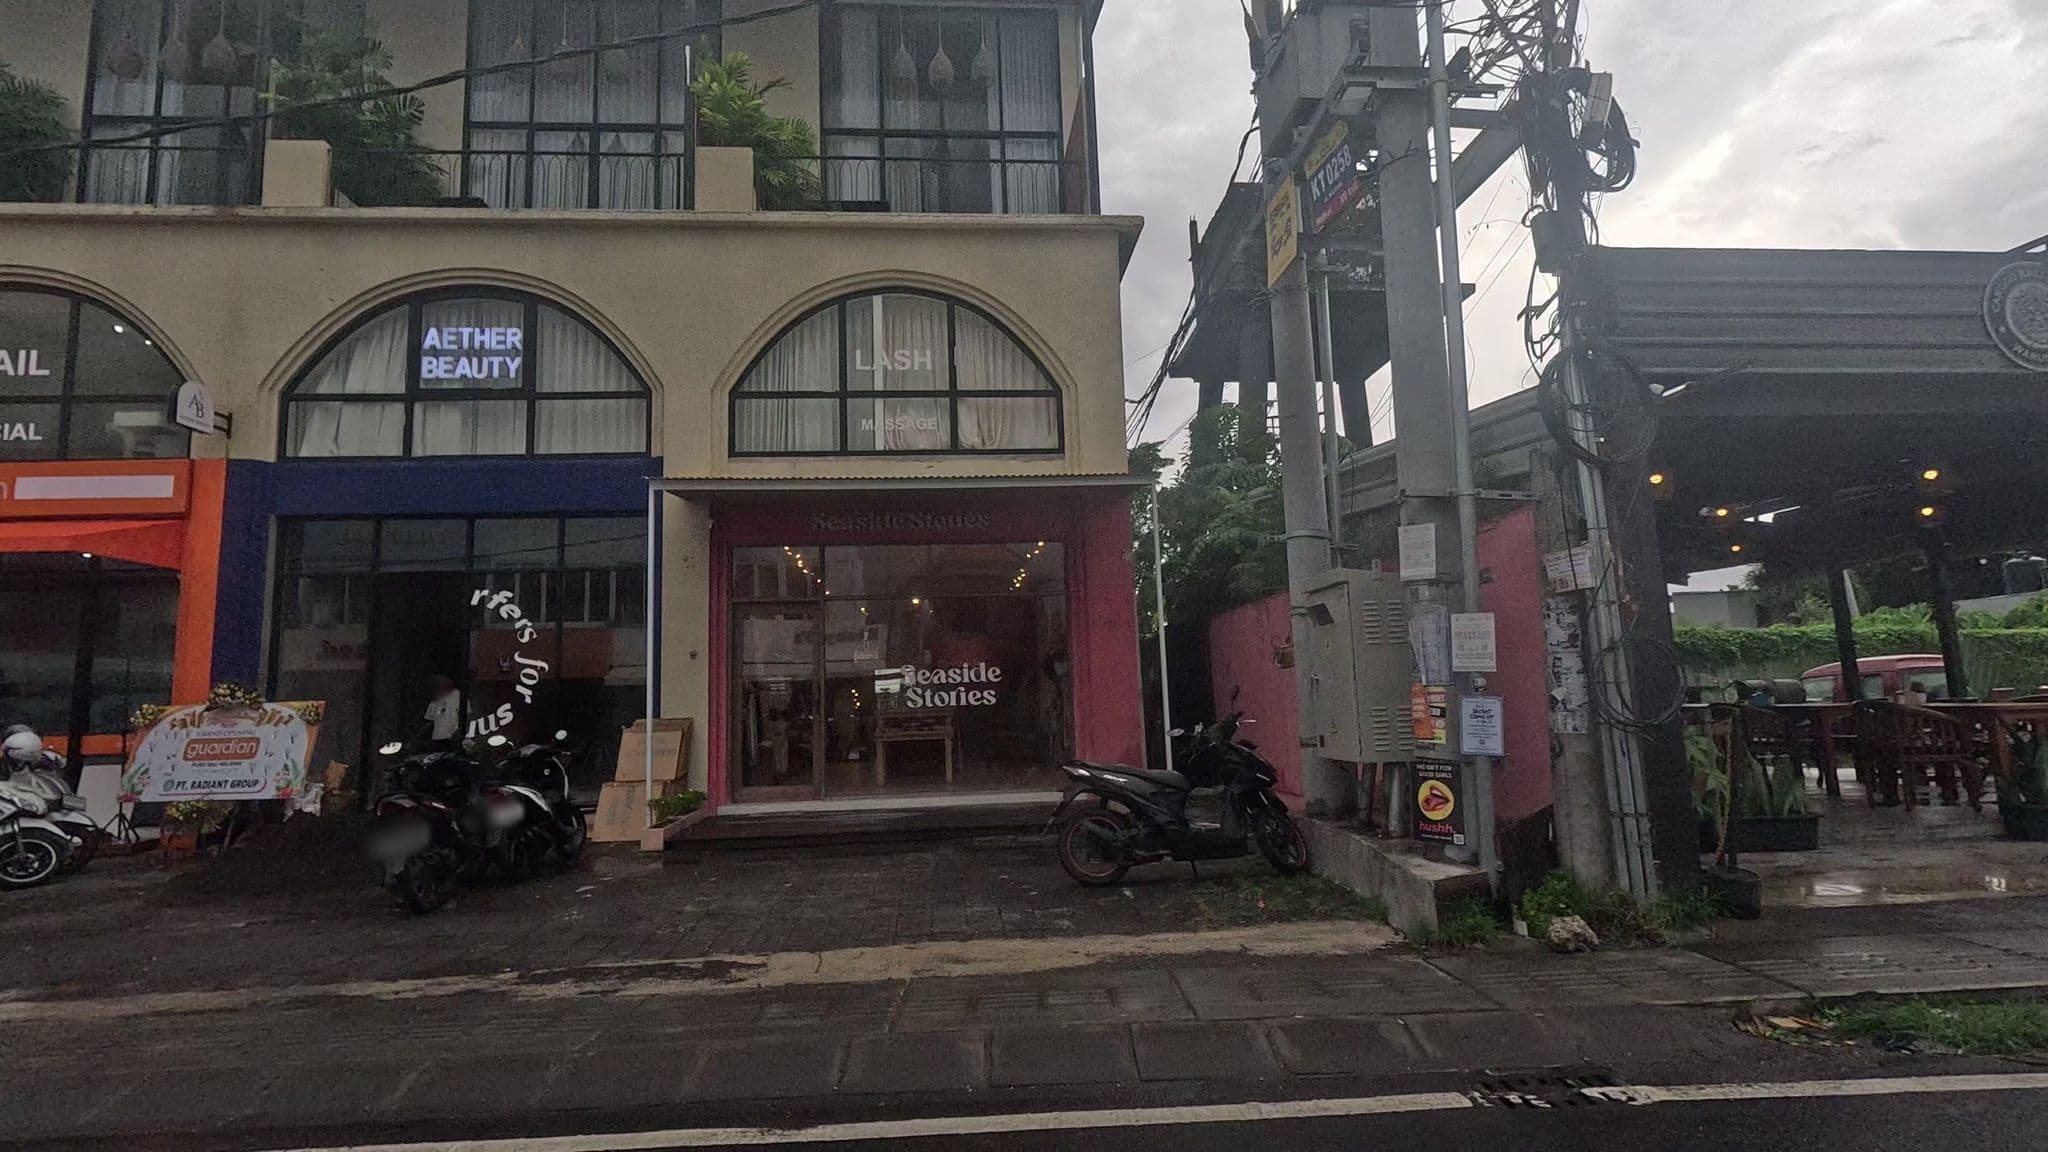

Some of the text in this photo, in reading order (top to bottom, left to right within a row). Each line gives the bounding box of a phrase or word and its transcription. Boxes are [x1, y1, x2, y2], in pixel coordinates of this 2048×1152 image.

[423, 327, 522, 350] AETHER
[421, 356, 521, 379] BEAUTY
[855, 349, 932, 371] LASH
[0, 422, 43, 441] IAL
[861, 418, 937, 431] MASSAGE
[814, 510, 904, 529] Seaside
[900, 662, 1002, 685] Seaside
[905, 686, 997, 708] Stories
[186, 738, 257, 759] guardian
[190, 780, 228, 790] RADIANT
[230, 779, 260, 789] GROUP
